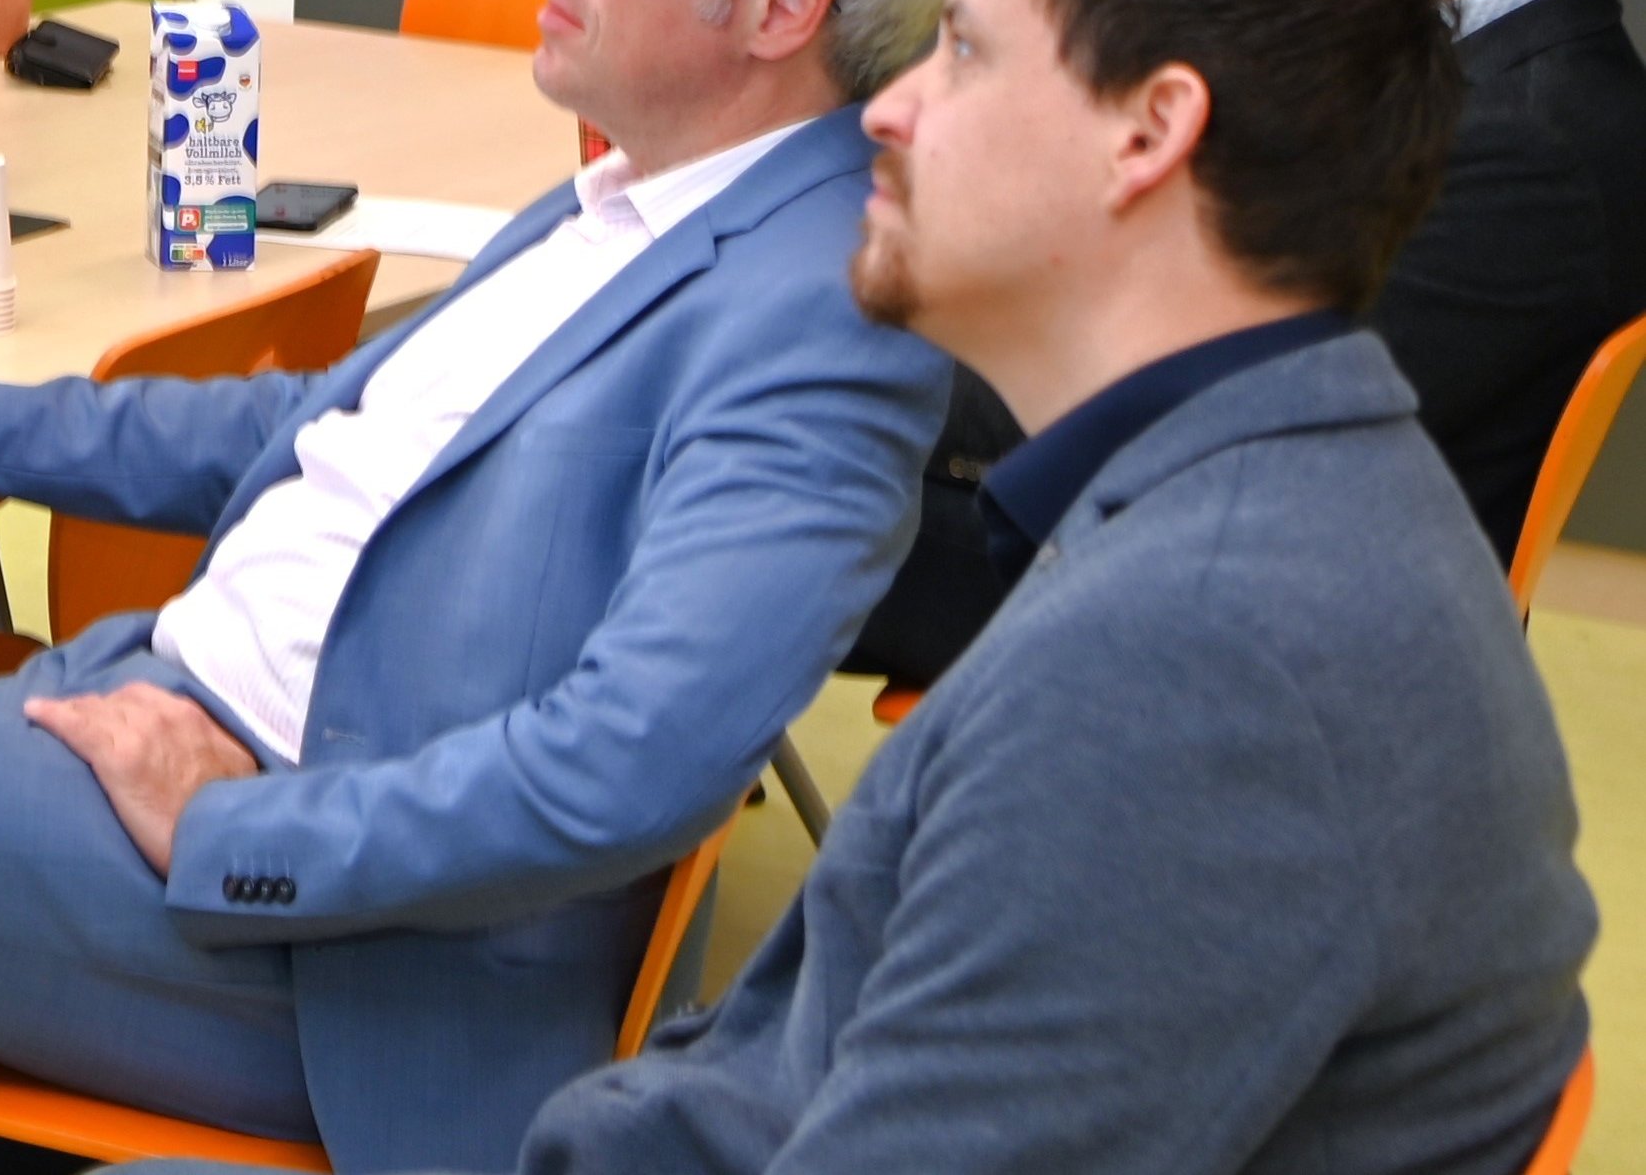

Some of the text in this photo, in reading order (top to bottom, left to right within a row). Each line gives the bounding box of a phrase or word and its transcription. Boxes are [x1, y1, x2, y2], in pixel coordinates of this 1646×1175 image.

[189, 135, 240, 148] haltbare
[185, 147, 242, 159] Vollmilch
[218, 175, 242, 186] Fett
